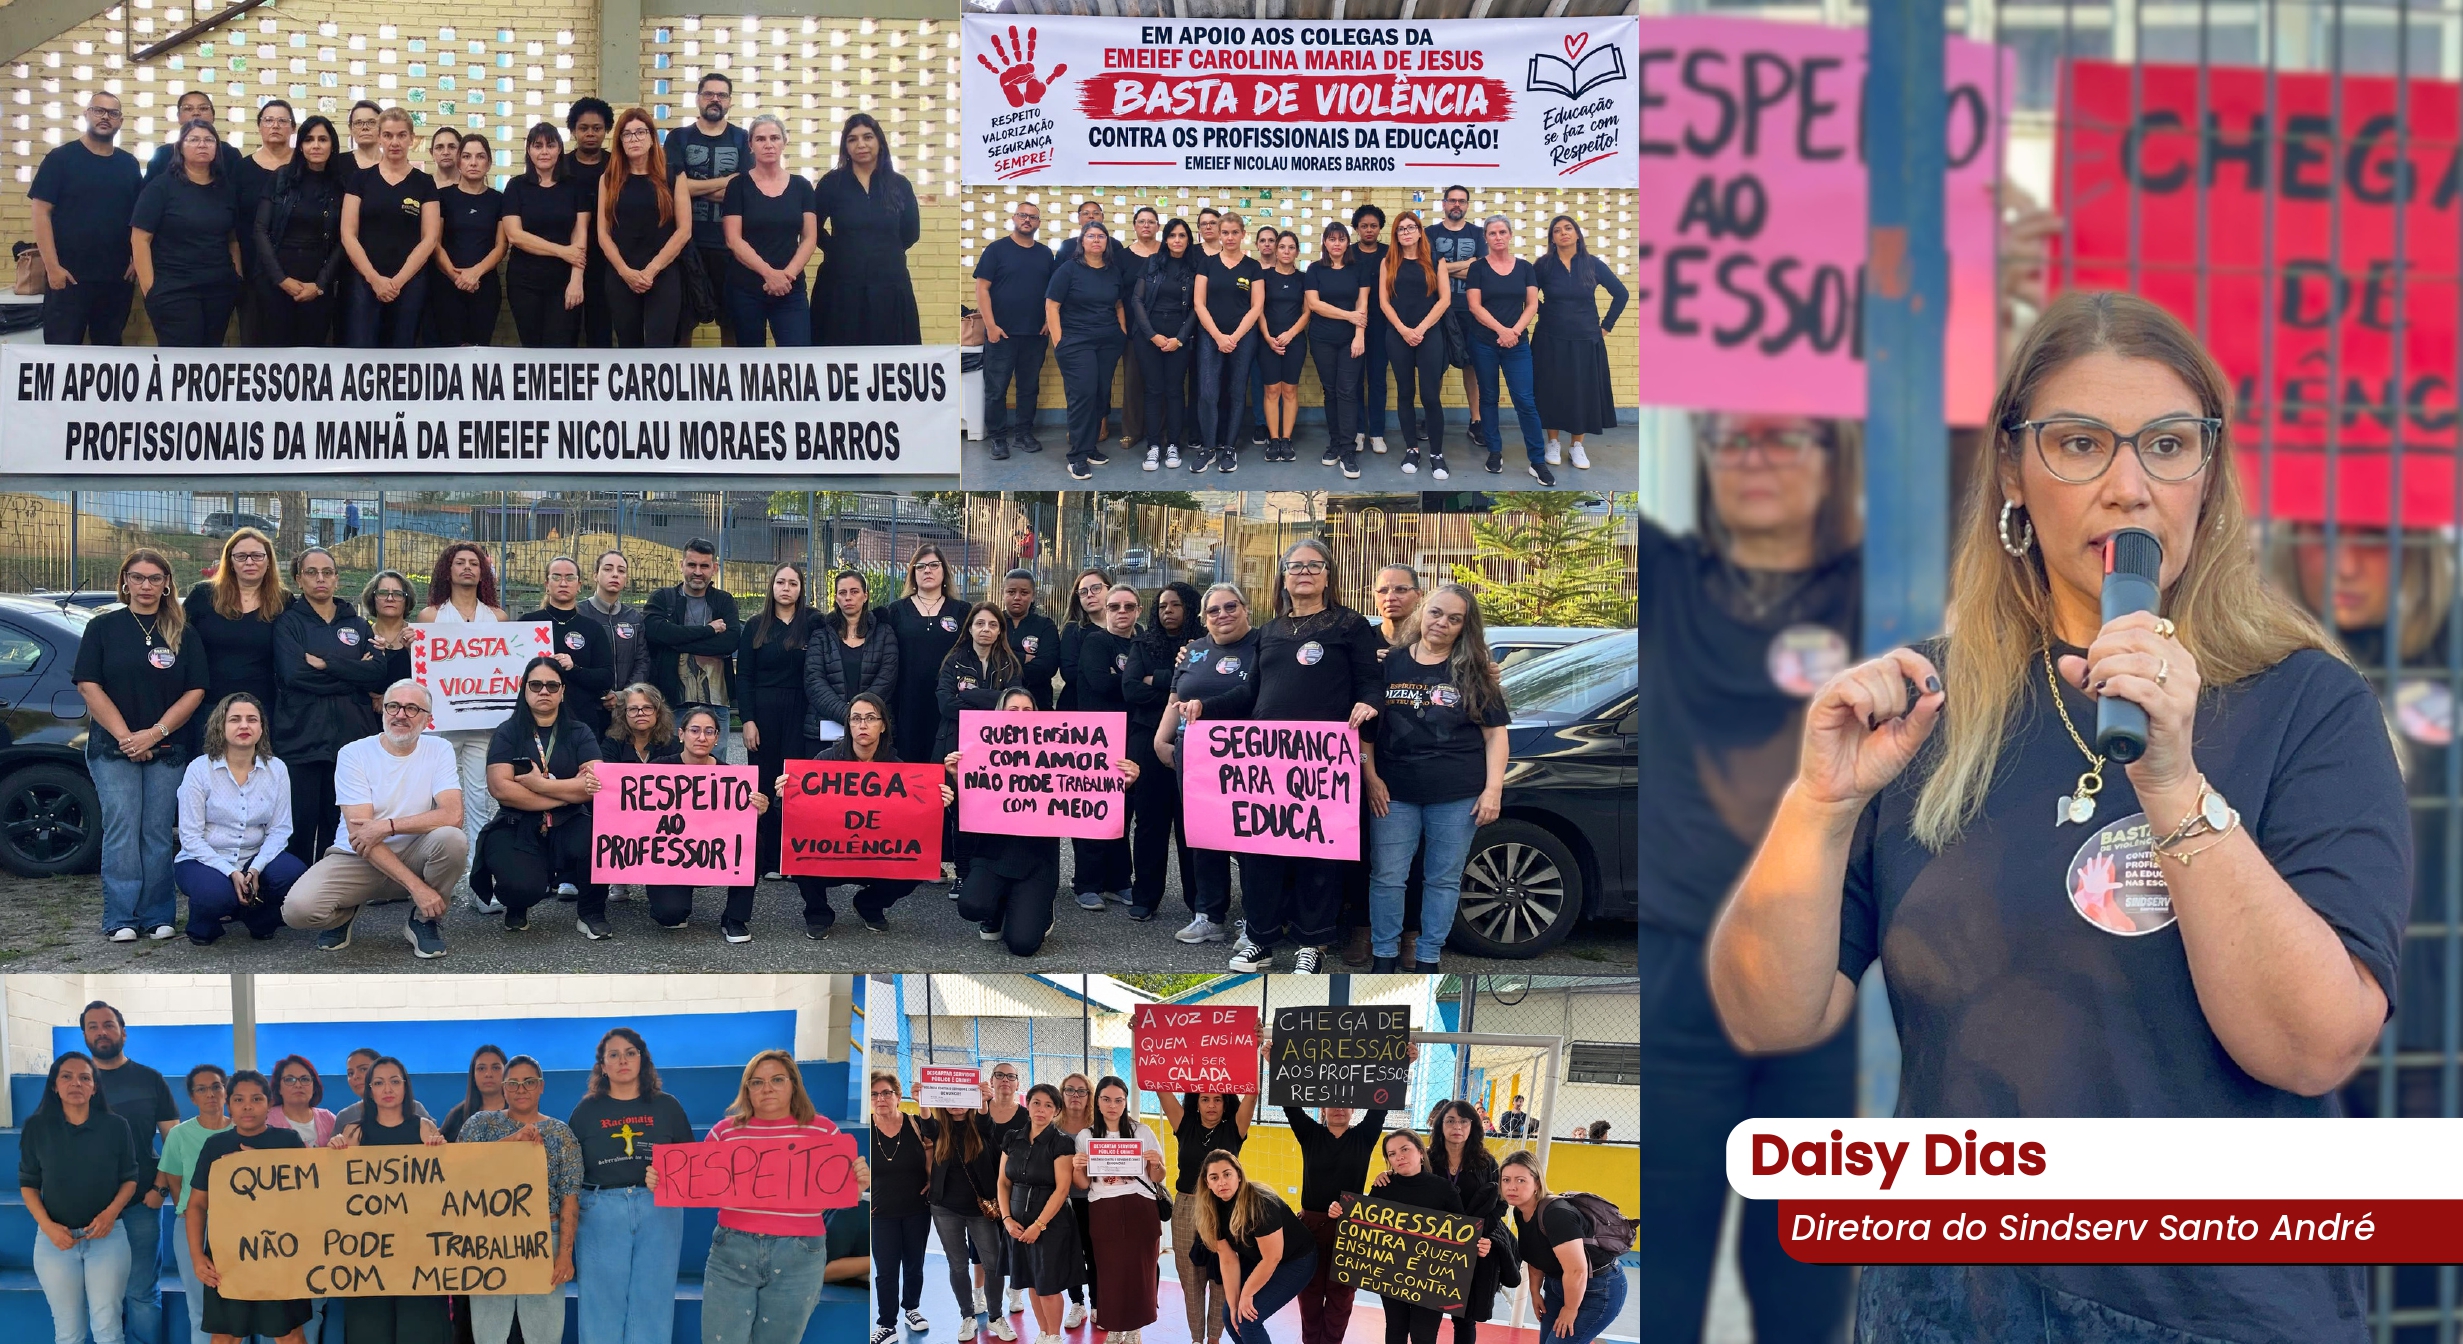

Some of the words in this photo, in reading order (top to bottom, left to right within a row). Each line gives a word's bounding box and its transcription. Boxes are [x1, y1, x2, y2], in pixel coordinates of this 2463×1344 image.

[1142, 26, 1172, 44] EM
[1178, 26, 1246, 45] APOIO
[1251, 27, 1294, 45] AOS
[1301, 28, 1398, 45] COLEGAS
[1405, 28, 1434, 45] DA
[1104, 48, 1183, 69] EMEIEF
[1189, 49, 1298, 70] CAROLINA
[1305, 50, 1377, 71] MARIA
[1384, 50, 1412, 71] DE
[1418, 50, 1484, 71] JESUS
[1111, 79, 1239, 116] BASTA
[1253, 81, 1300, 116] DE
[1315, 73, 1489, 116] VIOLÊNCIA
[991, 108, 1041, 127] RESPEITO
[1543, 97, 1614, 130] Educação
[982, 119, 1054, 144] VALORIZAÇÃO
[1088, 126, 1167, 148] CONTRA
[1172, 127, 1198, 148] OS
[1203, 127, 1350, 148] PROFISSIONAIS
[1355, 128, 1380, 149] DA
[1385, 124, 1499, 155] EDUCAÇÃO!
[1544, 132, 1558, 145] se
[1563, 124, 1584, 143] faz
[1590, 115, 1619, 131] com
[988, 135, 1052, 158] SEGURANÇA
[1550, 128, 1618, 166] Respeito!
[994, 147, 1054, 172] SEMPRE!
[1185, 156, 1231, 170] EMEIEF
[1234, 156, 1287, 170] NICOLAU
[1291, 157, 1342, 171] MORAES
[1346, 157, 1395, 171] BARROS
[1676, 173, 1769, 241] AO
[2280, 258, 2414, 332] DE
[18, 362, 54, 401] EM
[61, 362, 139, 402] APOIO
[147, 354, 164, 402] À
[172, 362, 332, 402] PROFESSORA
[340, 362, 465, 401] AGREDIDA
[472, 363, 505, 400] NA
[514, 362, 600, 401] EMEIEF
[607, 362, 734, 402] CAROLINA
[740, 362, 821, 402] MARIA
[827, 362, 861, 401] DE
[866, 362, 946, 402] JESUS
[65, 420, 264, 462] PROFISSIONAIS
[273, 421, 306, 460] DA
[315, 412, 407, 460] MANHÃ
[417, 420, 450, 460] DA
[458, 420, 550, 460] EMEIEF
[558, 420, 671, 460] NICOLAU
[680, 420, 788, 461] MORAES
[799, 420, 900, 462] BARROS
[431, 637, 511, 662] BASTA
[439, 667, 523, 697] VIOLÊN
[980, 724, 1028, 745] QUEM
[1209, 725, 1356, 766] SEGURANÇA
[989, 750, 1030, 767] COM
[1035, 750, 1109, 771] AMOR
[801, 771, 907, 798] CHEGA
[965, 766, 1003, 791] NÃO
[1009, 773, 1053, 793] PODE
[1056, 774, 1125, 794] TRABALHAR
[1219, 764, 1275, 795] PARA
[1286, 766, 1350, 804] QUEM
[845, 810, 881, 829] DE
[1003, 798, 1037, 813] COM
[1047, 798, 1108, 820] MEDO
[656, 813, 685, 835] AO
[1232, 801, 1334, 844] EDUCA.
[791, 834, 922, 854] VIOLÊNCIA
[2114, 839, 2153, 850] VIOLÊNC
[2125, 870, 2138, 878] DA
[2126, 898, 2171, 907] SINDSERV
[1141, 1009, 1156, 1028] A
[1165, 1012, 1202, 1027] VOZ
[1213, 1011, 1237, 1024] DE
[1378, 1012, 1404, 1030] DE
[1141, 1037, 1187, 1052] QUEM
[1282, 1034, 1407, 1063] AGRESSÃO
[1139, 1054, 1165, 1066] NÃO
[1202, 1057, 1226, 1065] SER
[1276, 1064, 1314, 1080] AOS
[1168, 1067, 1231, 1081] CALADA
[1190, 1084, 1205, 1092] DE
[1291, 1084, 1354, 1104] RES!!!
[230, 1162, 319, 1201] QUEM
[346, 1192, 408, 1216] COM
[441, 1183, 533, 1218] AMOR
[1350, 1201, 1475, 1243] AGRESSÃO
[239, 1229, 298, 1261] NÃO
[324, 1228, 395, 1258] PODE
[426, 1231, 549, 1260] TRABALHAR
[1339, 1220, 1406, 1251] CONTRA
[1415, 1241, 1468, 1268] QUEM
[306, 1264, 385, 1294] COM
[412, 1265, 506, 1291] MEDO
[1406, 1255, 1421, 1270] É
[1429, 1264, 1455, 1280] UM
[1338, 1271, 1349, 1283] O
[1361, 1277, 1421, 1301] FUTURO
[1394, 1272, 1462, 1300] CONTRA
